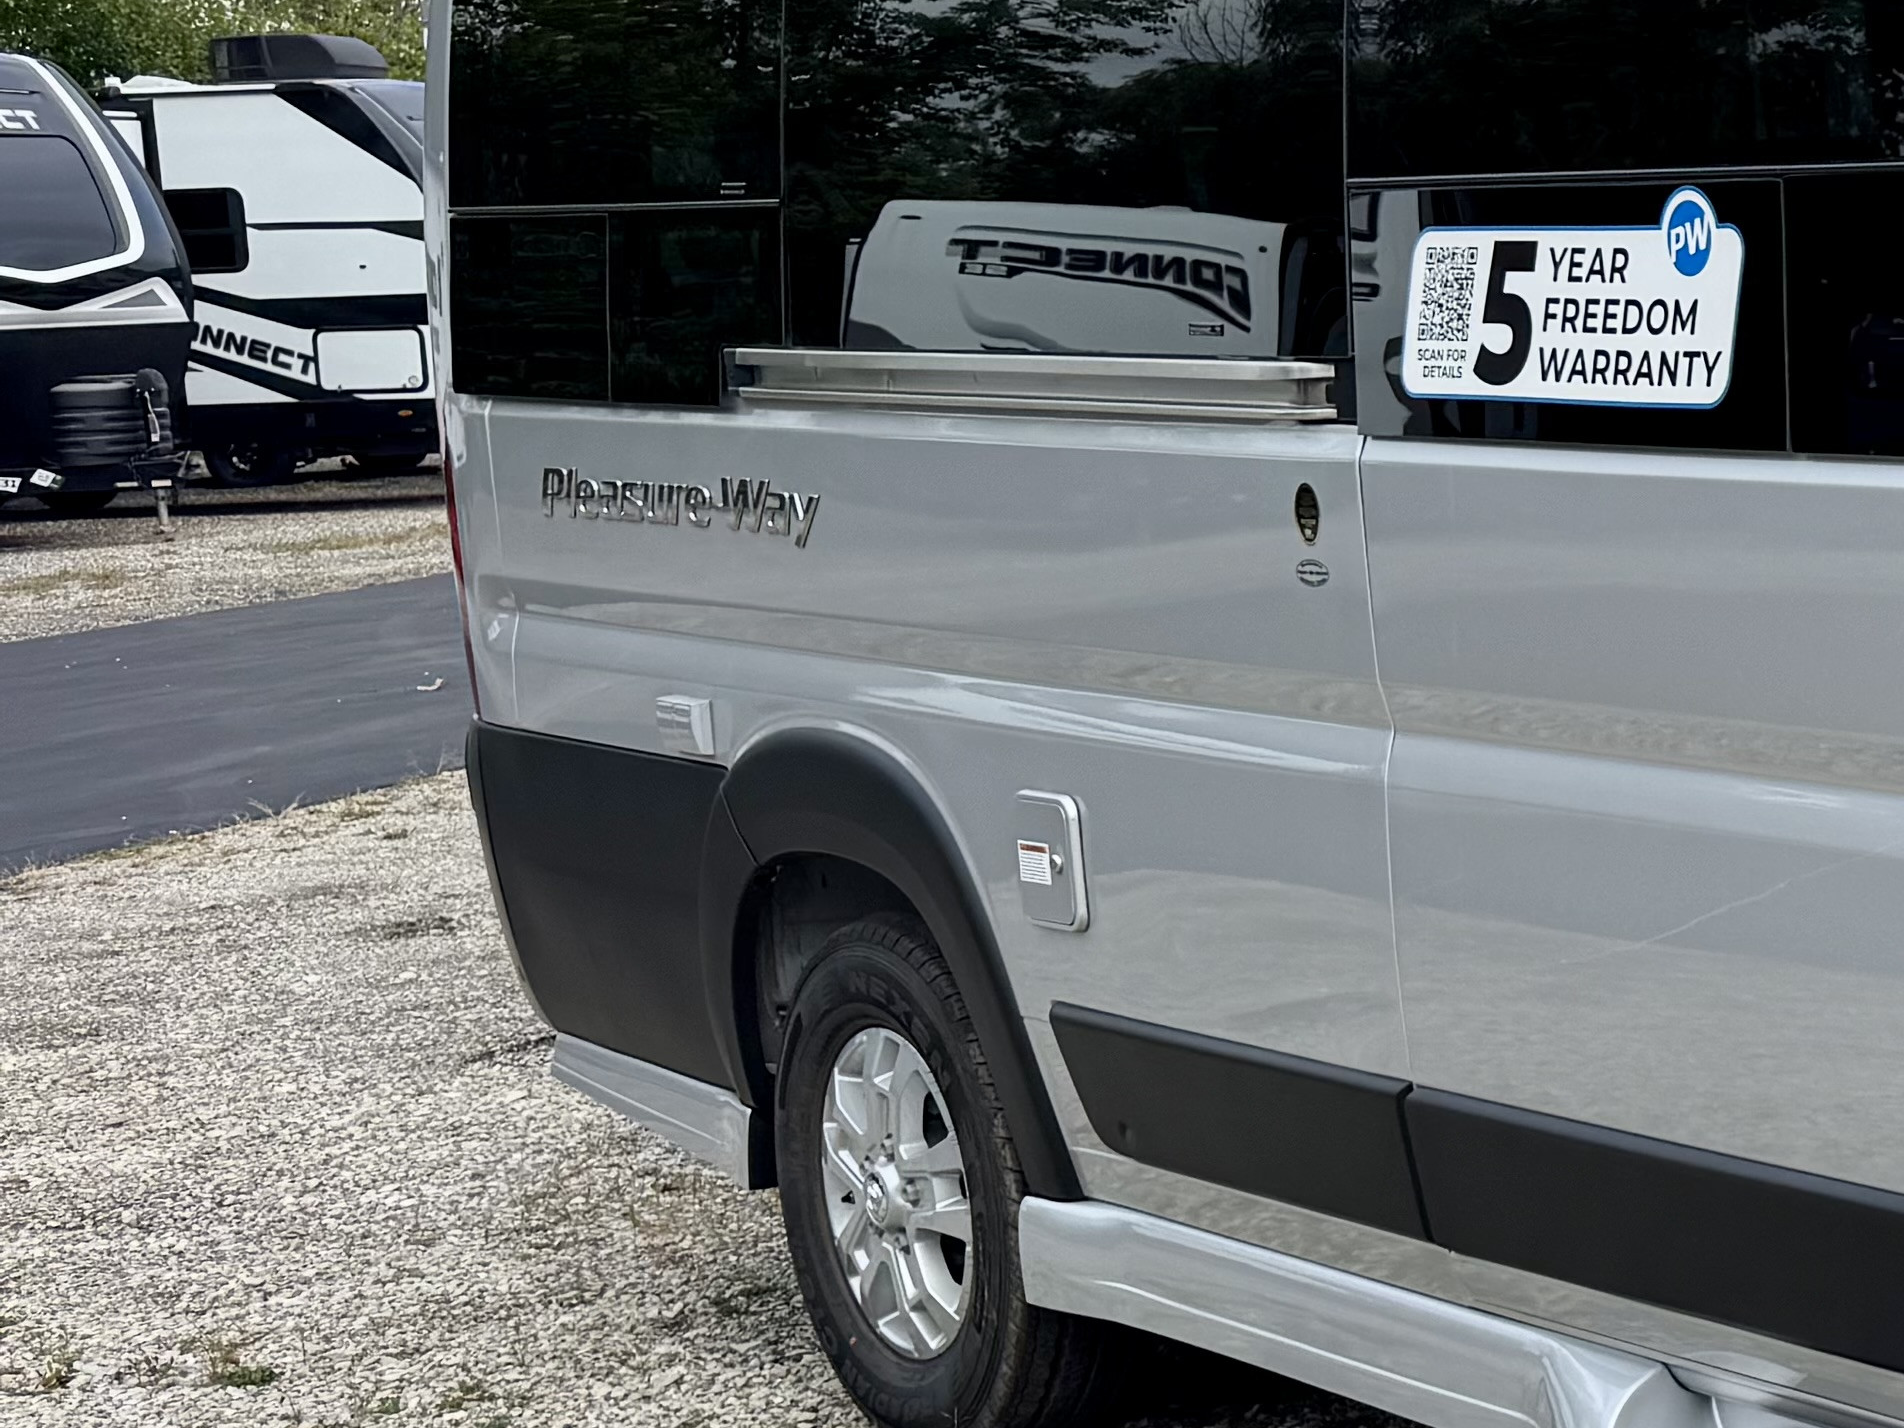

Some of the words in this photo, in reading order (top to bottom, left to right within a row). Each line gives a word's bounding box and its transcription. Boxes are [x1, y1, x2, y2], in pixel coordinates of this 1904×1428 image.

[0, 109, 41, 130] CT
[1669, 212, 1712, 264] PW
[1549, 246, 1630, 284] YEAR
[1473, 239, 1540, 386] 5
[1542, 297, 1699, 336] FREEDOM
[1417, 348, 1444, 363] SCAN
[1446, 349, 1467, 363] FOR
[1422, 365, 1463, 379] DETAILS
[1539, 347, 1723, 387] WARRANTY
[542, 466, 820, 549] Pleasure-Way
